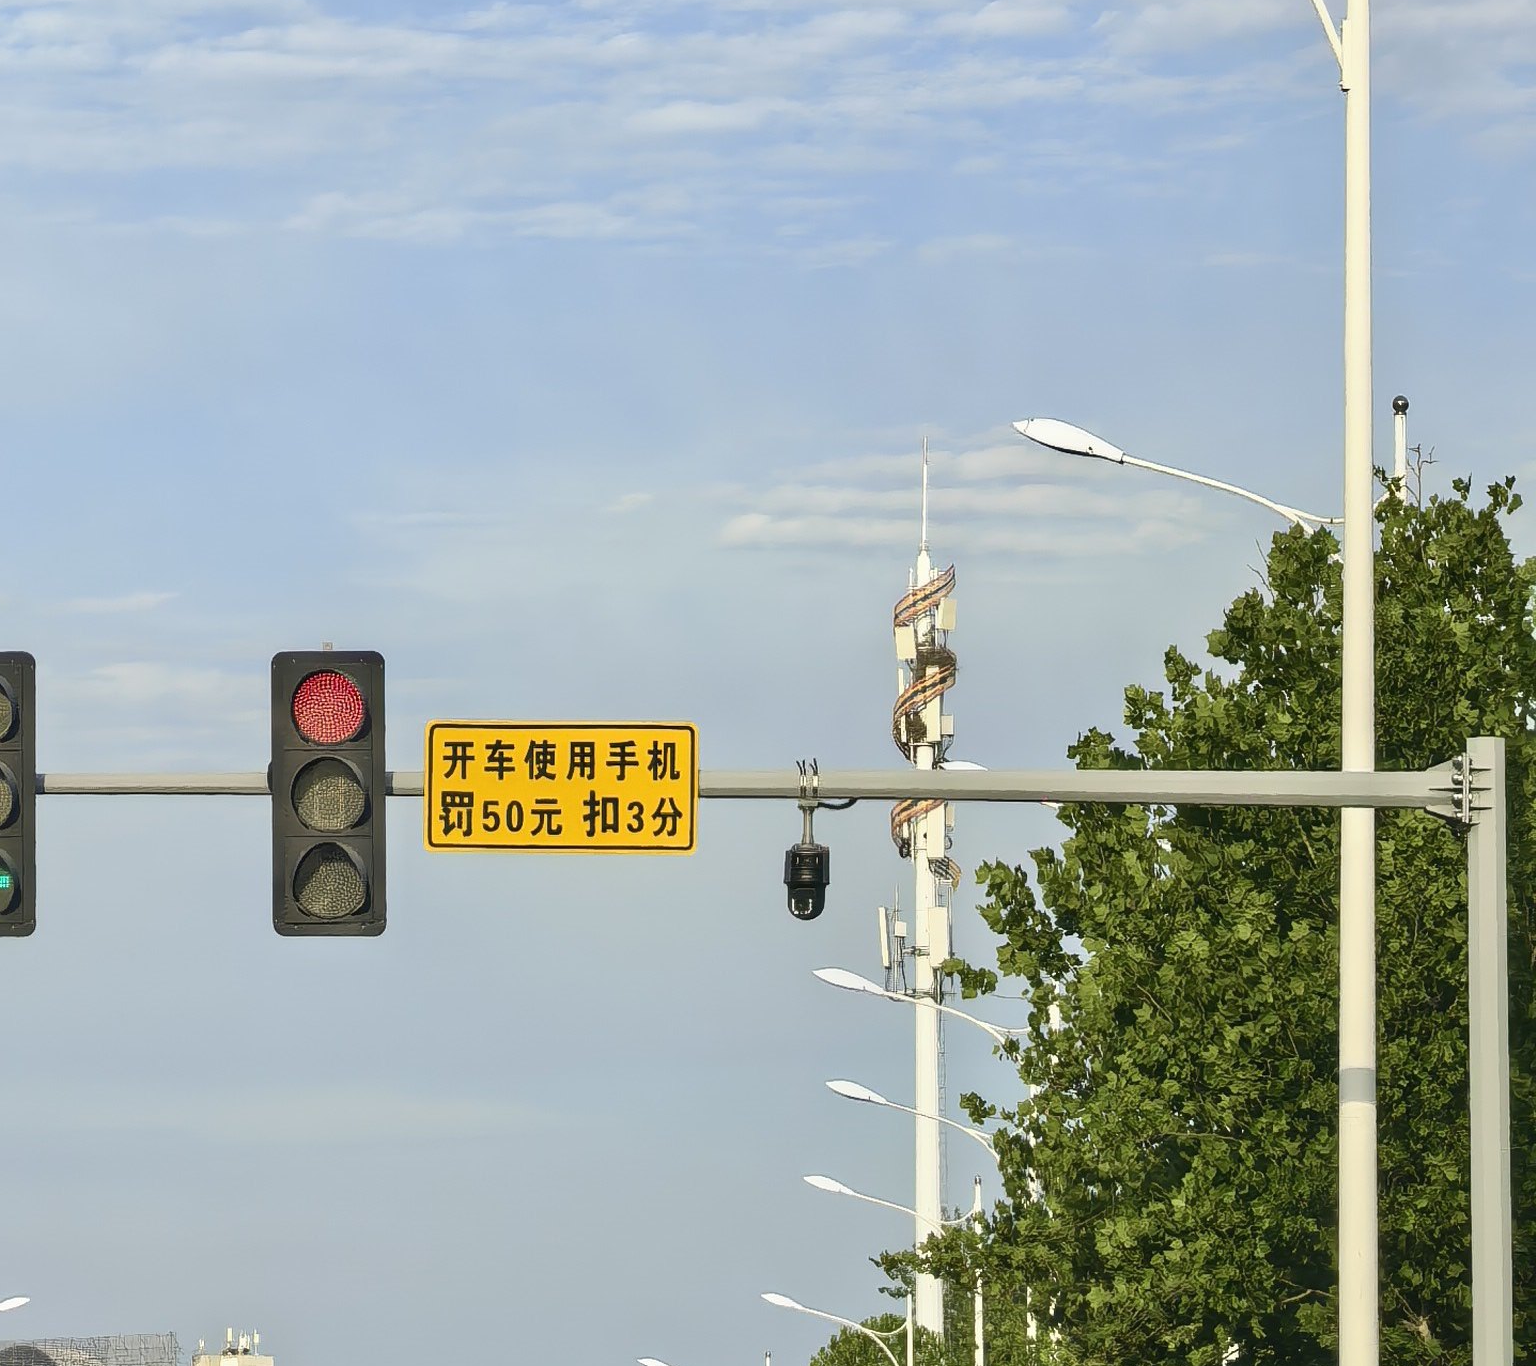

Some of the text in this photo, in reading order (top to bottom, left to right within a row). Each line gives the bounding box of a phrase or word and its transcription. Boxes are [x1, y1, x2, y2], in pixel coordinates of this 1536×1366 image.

[442, 740, 681, 781] 开车使用手机
